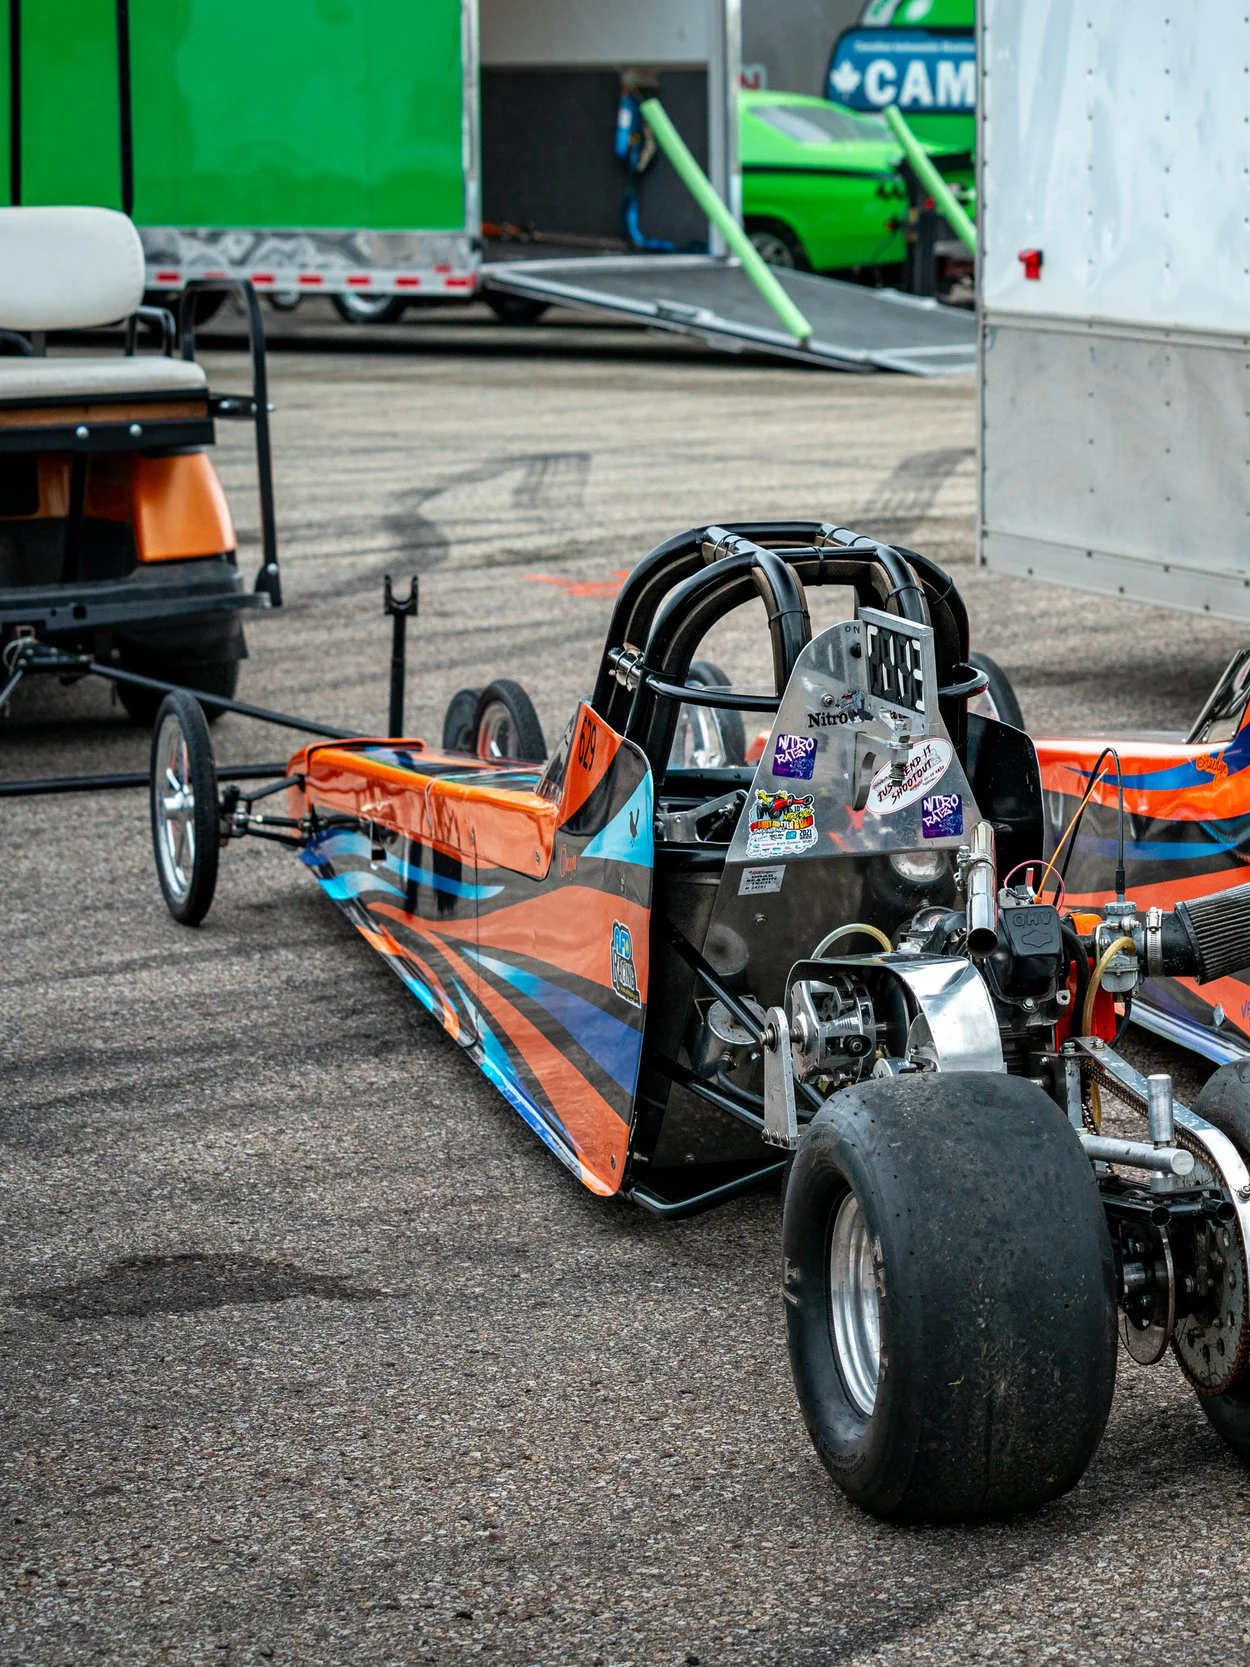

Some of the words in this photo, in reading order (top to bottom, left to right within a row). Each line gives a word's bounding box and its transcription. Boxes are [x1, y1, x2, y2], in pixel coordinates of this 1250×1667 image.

[578, 715, 597, 772] 629
[778, 734, 815, 751] NITRO
[923, 744, 931, 759] IT
[891, 759, 932, 805] SHOOTOUT
[923, 794, 959, 811] NITRO
[1013, 911, 1052, 927] OHV
